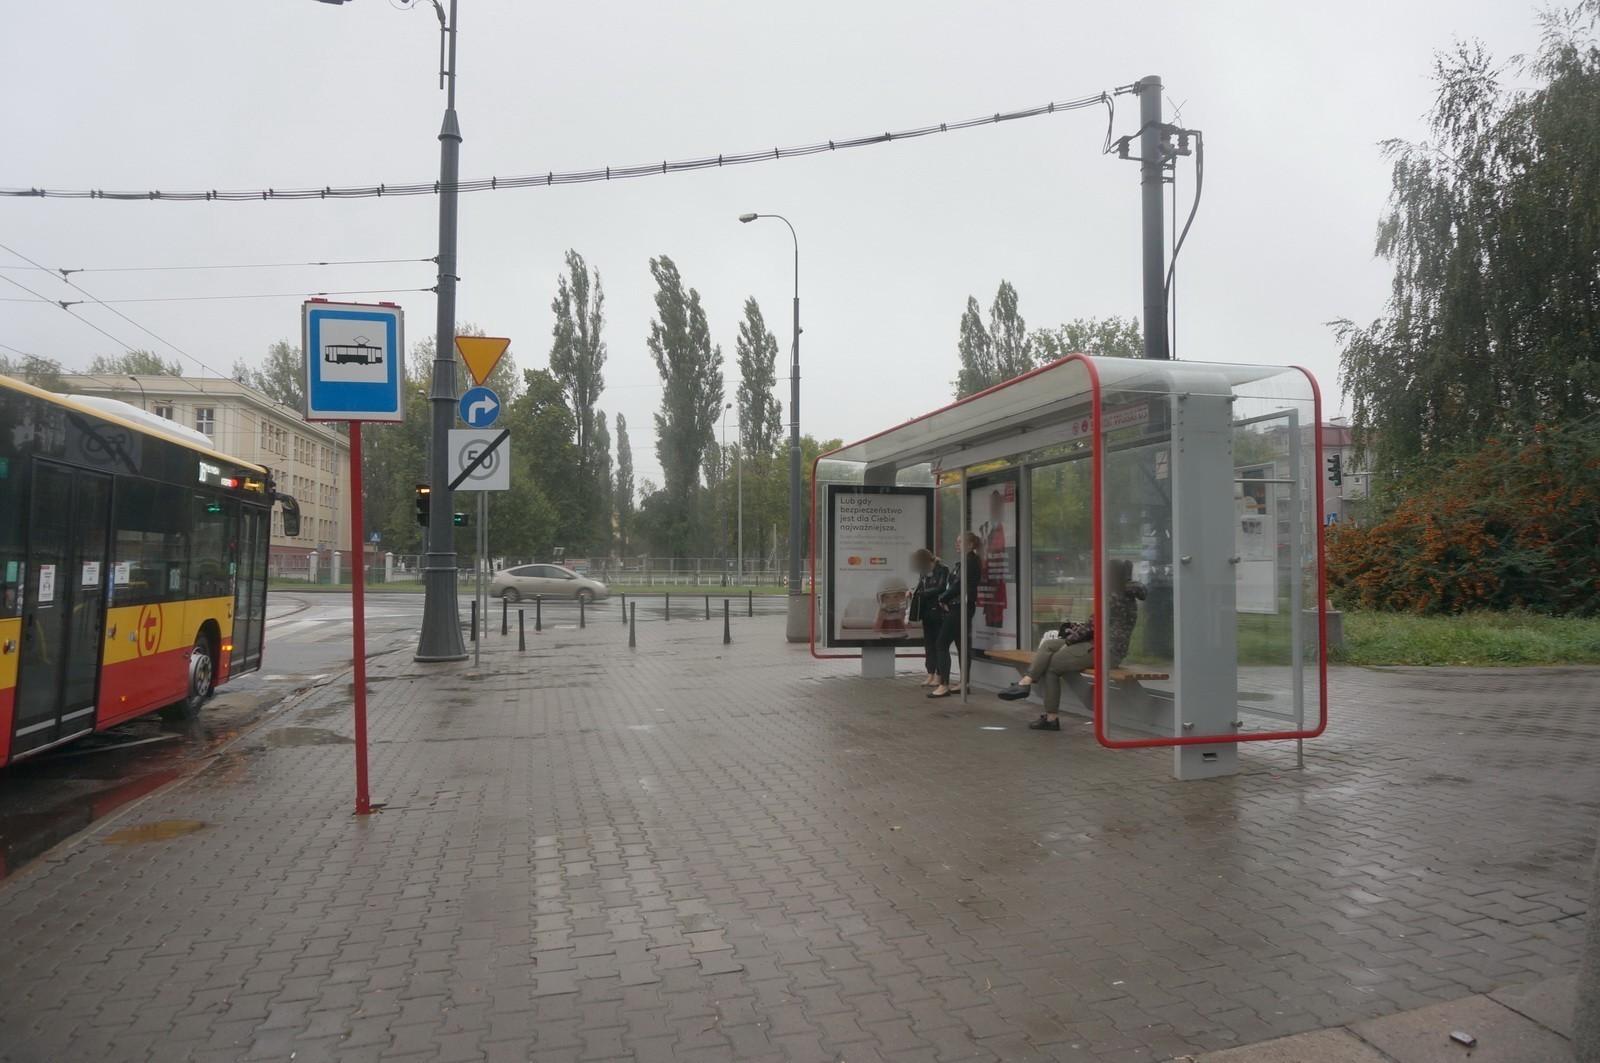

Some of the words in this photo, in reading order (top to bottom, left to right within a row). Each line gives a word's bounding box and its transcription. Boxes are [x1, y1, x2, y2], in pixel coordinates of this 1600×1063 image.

[467, 450, 494, 469] 50
[840, 496, 856, 505] Lub
[857, 497, 873, 506] gdy
[840, 506, 903, 515] bezpieczeństwo
[839, 514, 855, 523] jest
[856, 514, 869, 522] dla
[870, 515, 896, 523] Ciebie
[839, 523, 897, 533] najważniejsze.
